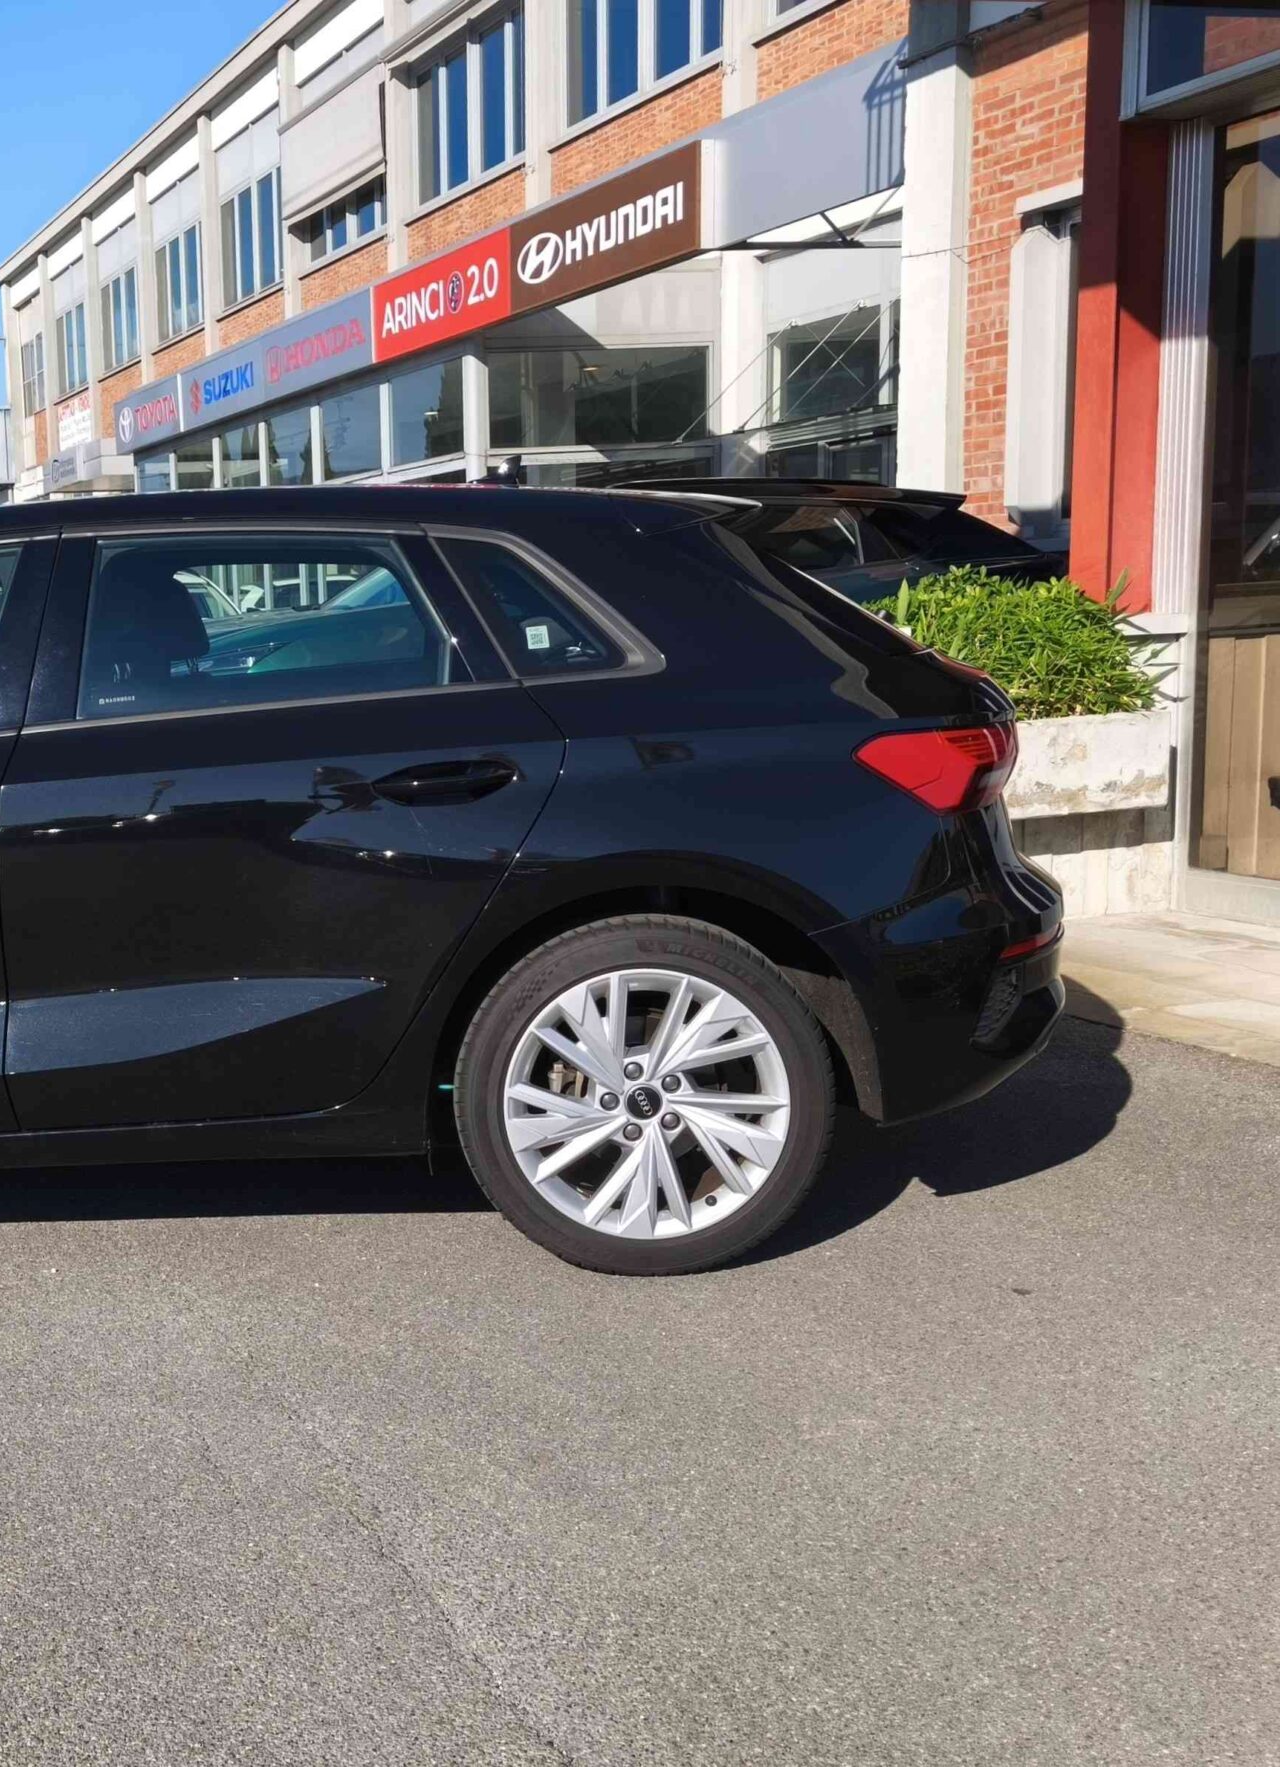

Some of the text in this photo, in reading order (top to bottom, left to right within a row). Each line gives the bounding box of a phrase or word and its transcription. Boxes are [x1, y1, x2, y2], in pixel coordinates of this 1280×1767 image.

[565, 181, 684, 265] HYUNDAI
[381, 257, 499, 338] ARINCI 2.0
[284, 319, 366, 371] HONDA
[203, 361, 254, 405] SUZUKI
[134, 394, 178, 432] TOYOTA
